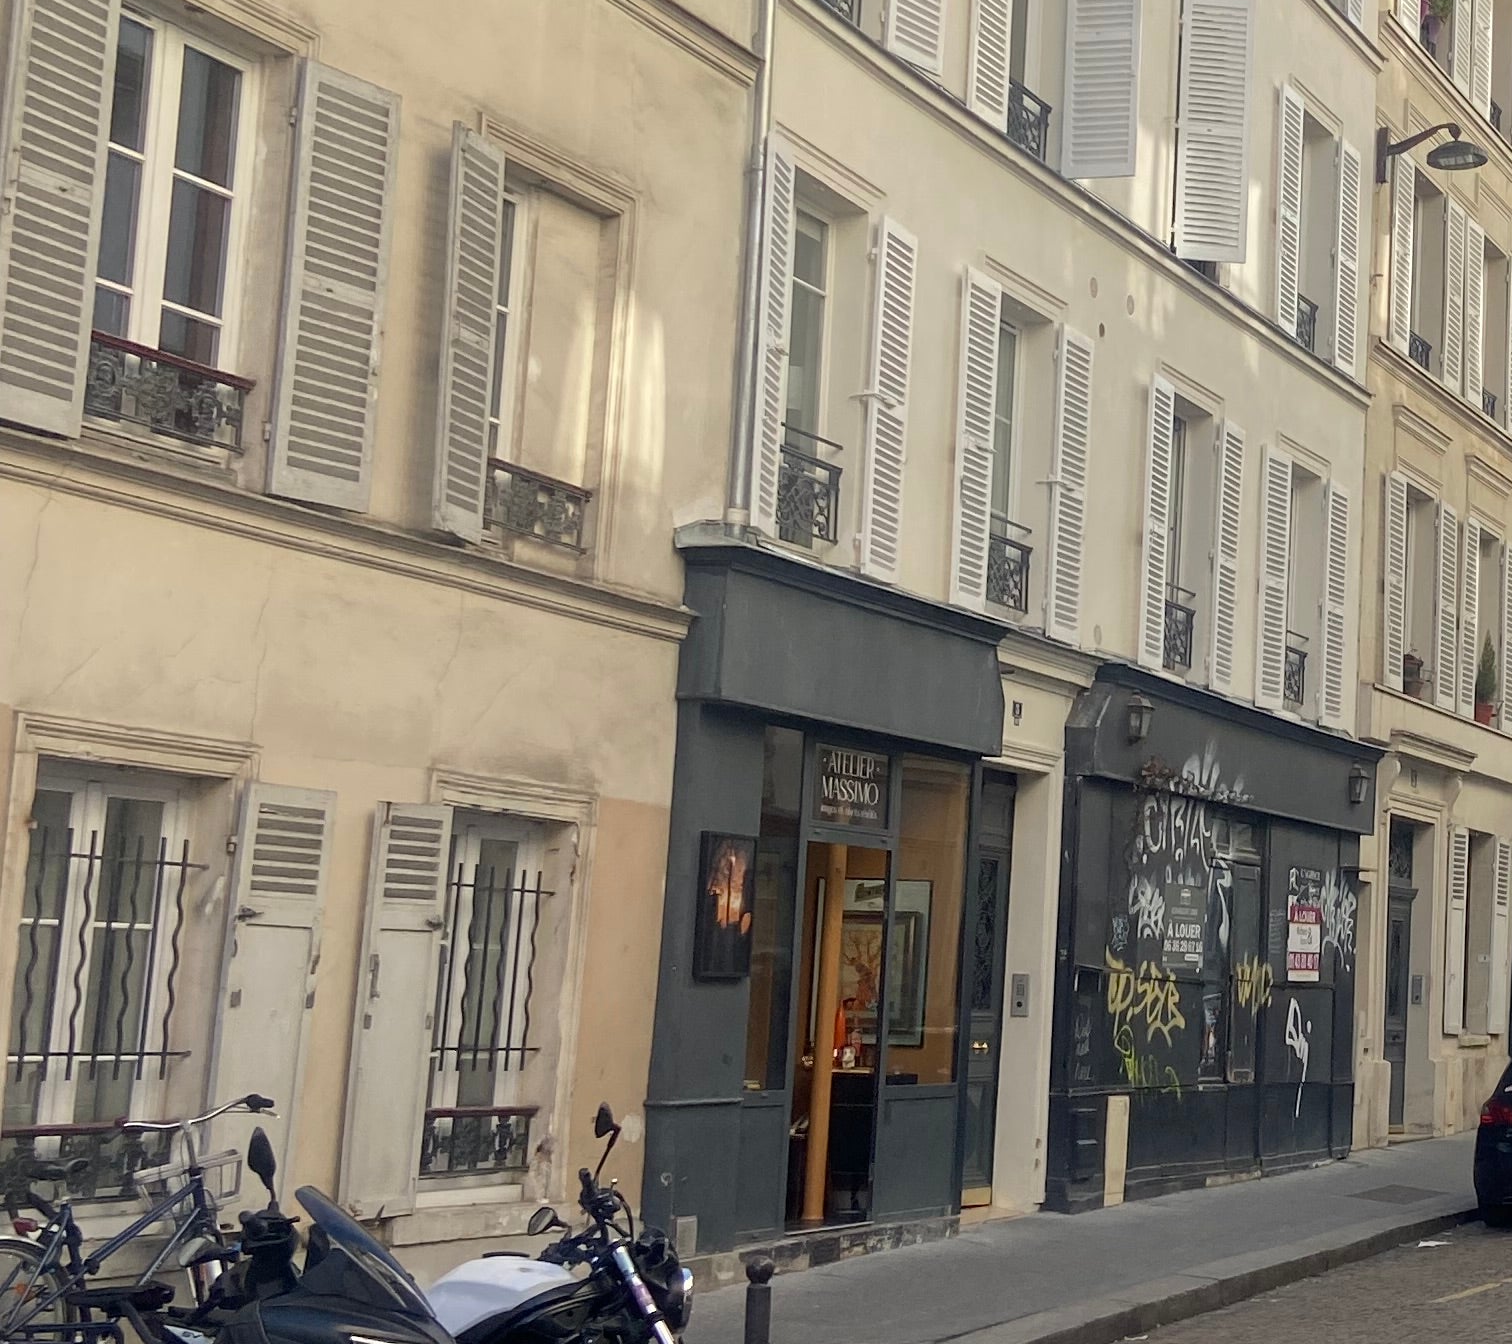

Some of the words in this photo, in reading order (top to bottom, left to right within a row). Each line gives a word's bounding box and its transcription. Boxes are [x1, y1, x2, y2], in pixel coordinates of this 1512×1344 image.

[827, 751, 876, 779] ATELIER
[822, 775, 879, 806] MASSIMO
[1175, 922, 1201, 939] LOUER
